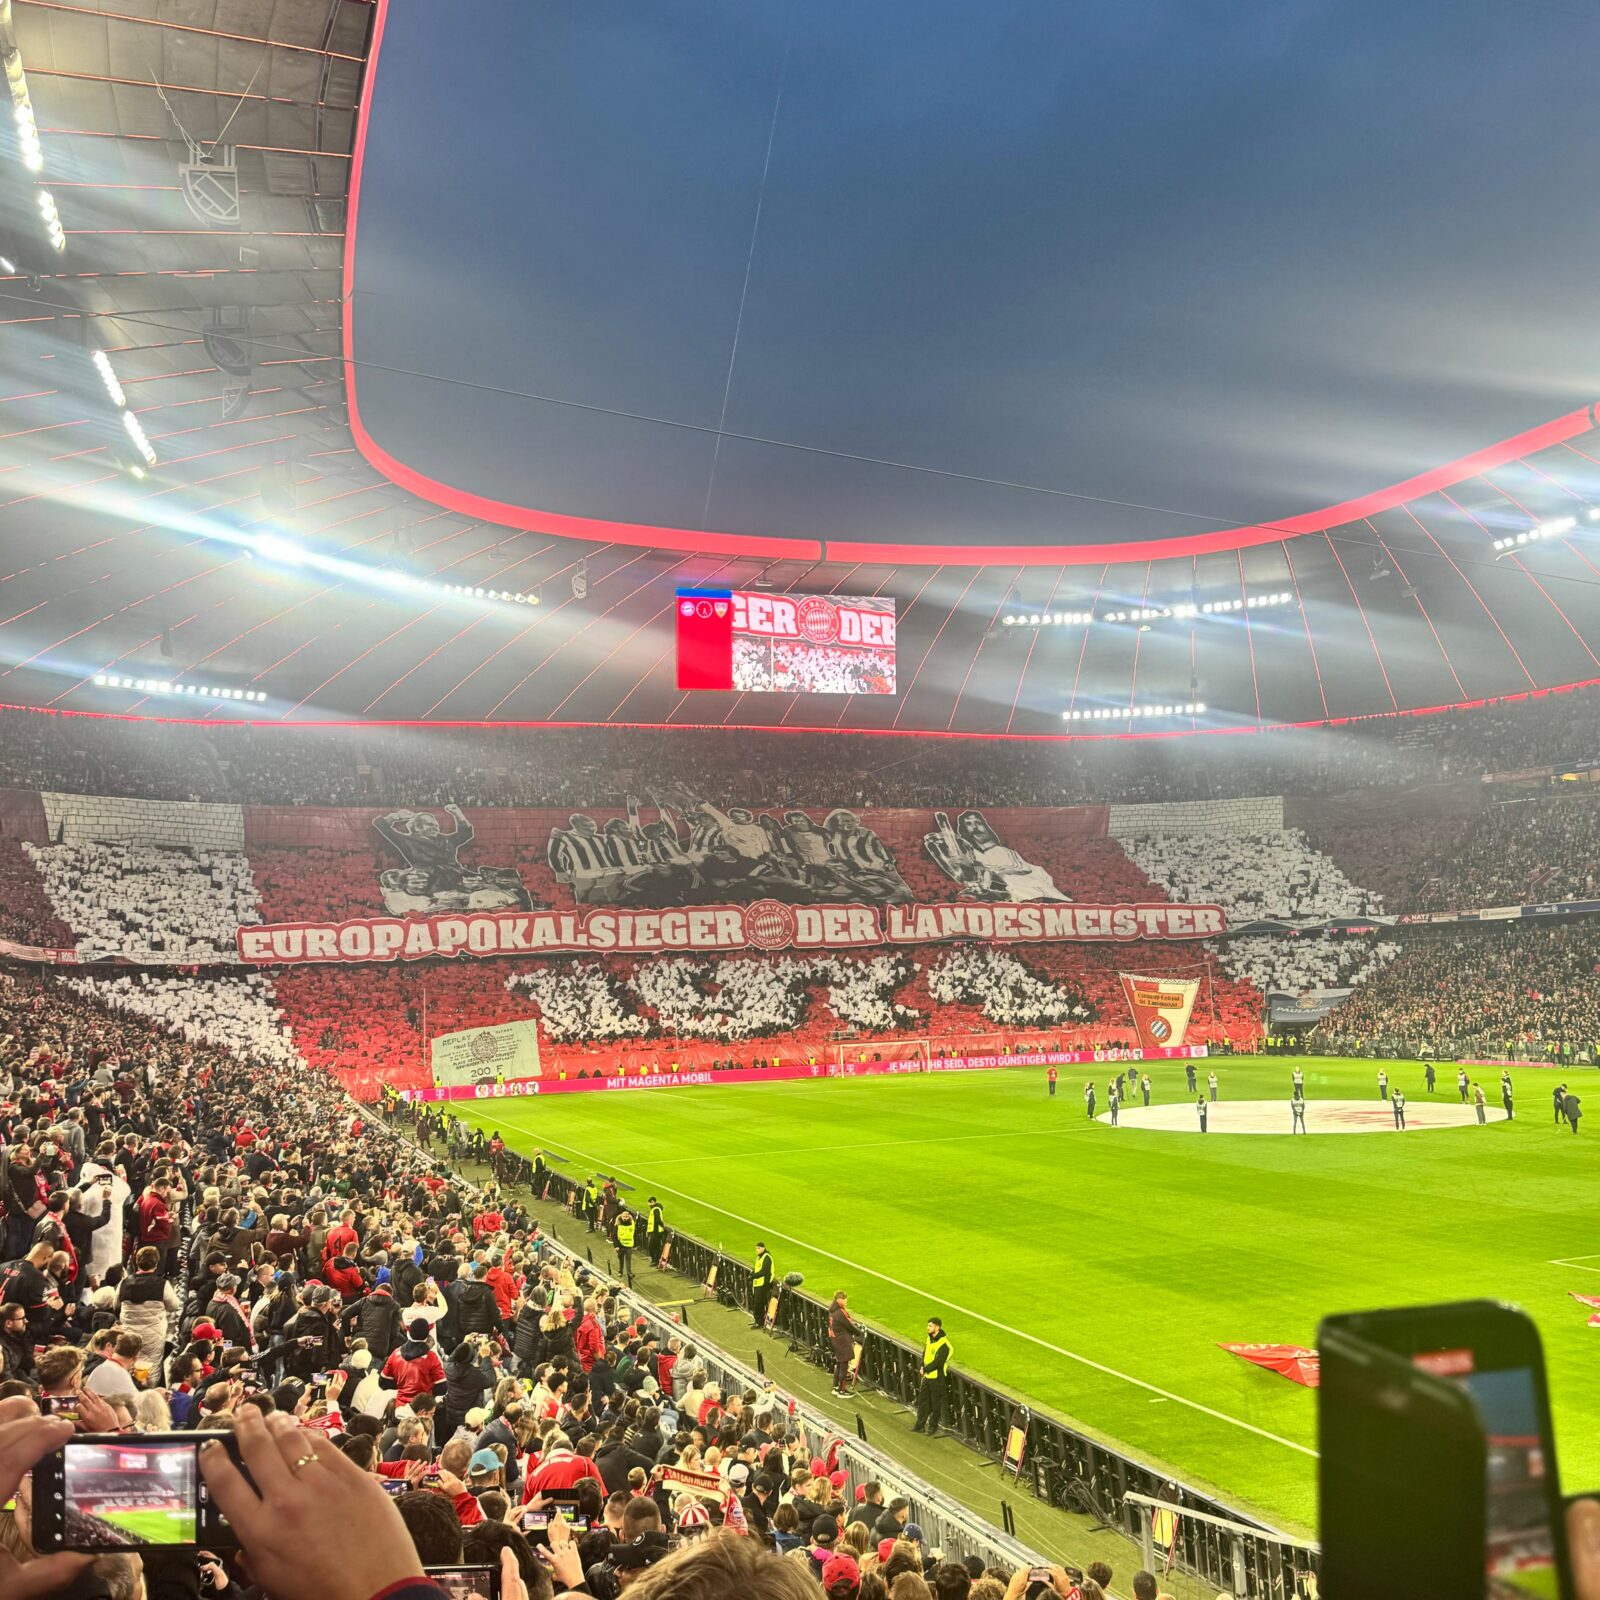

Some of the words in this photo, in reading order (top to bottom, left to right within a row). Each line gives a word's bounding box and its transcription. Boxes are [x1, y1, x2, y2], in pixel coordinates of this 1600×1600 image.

[758, 905, 790, 921] BAYERN
[241, 905, 745, 959] EUROPAPOKALSIEGER
[796, 908, 878, 943] DER
[890, 907, 1223, 939] LANDESMEISTER
[442, 1034, 471, 1046] REPLAY
[929, 1058, 943, 1070] HR
[968, 1056, 997, 1067] DESTO
[997, 1053, 1047, 1066] GÜNSTIGER
[470, 1066, 491, 1078] 200
[496, 1064, 504, 1073] F
[607, 1078, 627, 1089] MIT
[628, 1074, 680, 1088] MAGENTA
[681, 1072, 714, 1084] MOBIL
